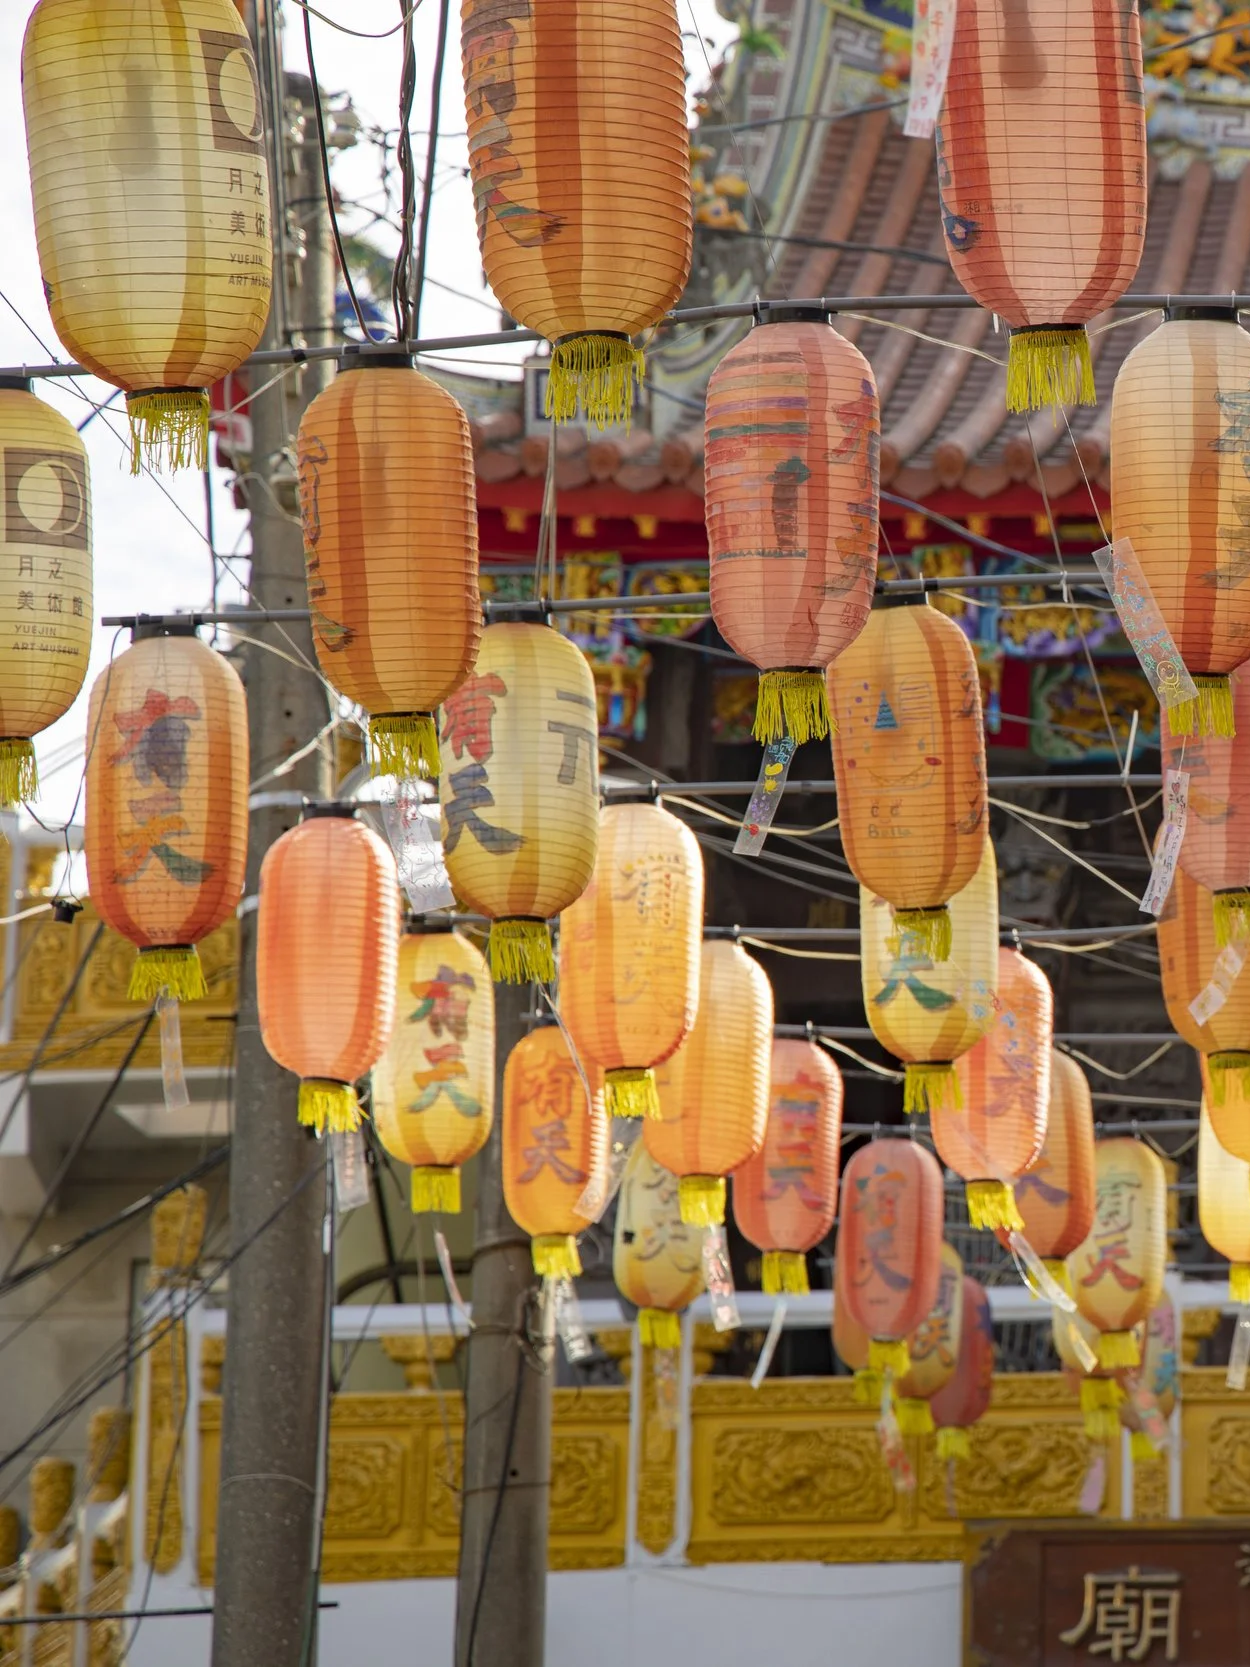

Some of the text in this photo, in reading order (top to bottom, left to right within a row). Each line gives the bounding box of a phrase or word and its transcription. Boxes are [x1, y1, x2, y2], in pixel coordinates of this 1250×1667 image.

[229, 168, 264, 196] 月之
[229, 252, 264, 266] YUEJIN
[228, 274, 248, 287] ART
[18, 555, 64, 581] 月之
[17, 590, 84, 618] 美術館
[14, 623, 57, 637] YUEJIN
[12, 640, 81, 656] ART MUSEUM
[439, 671, 529, 856] 有天
[108, 688, 216, 888] 有天
[407, 963, 483, 1119] 有天
[516, 1053, 588, 1186] 有天
